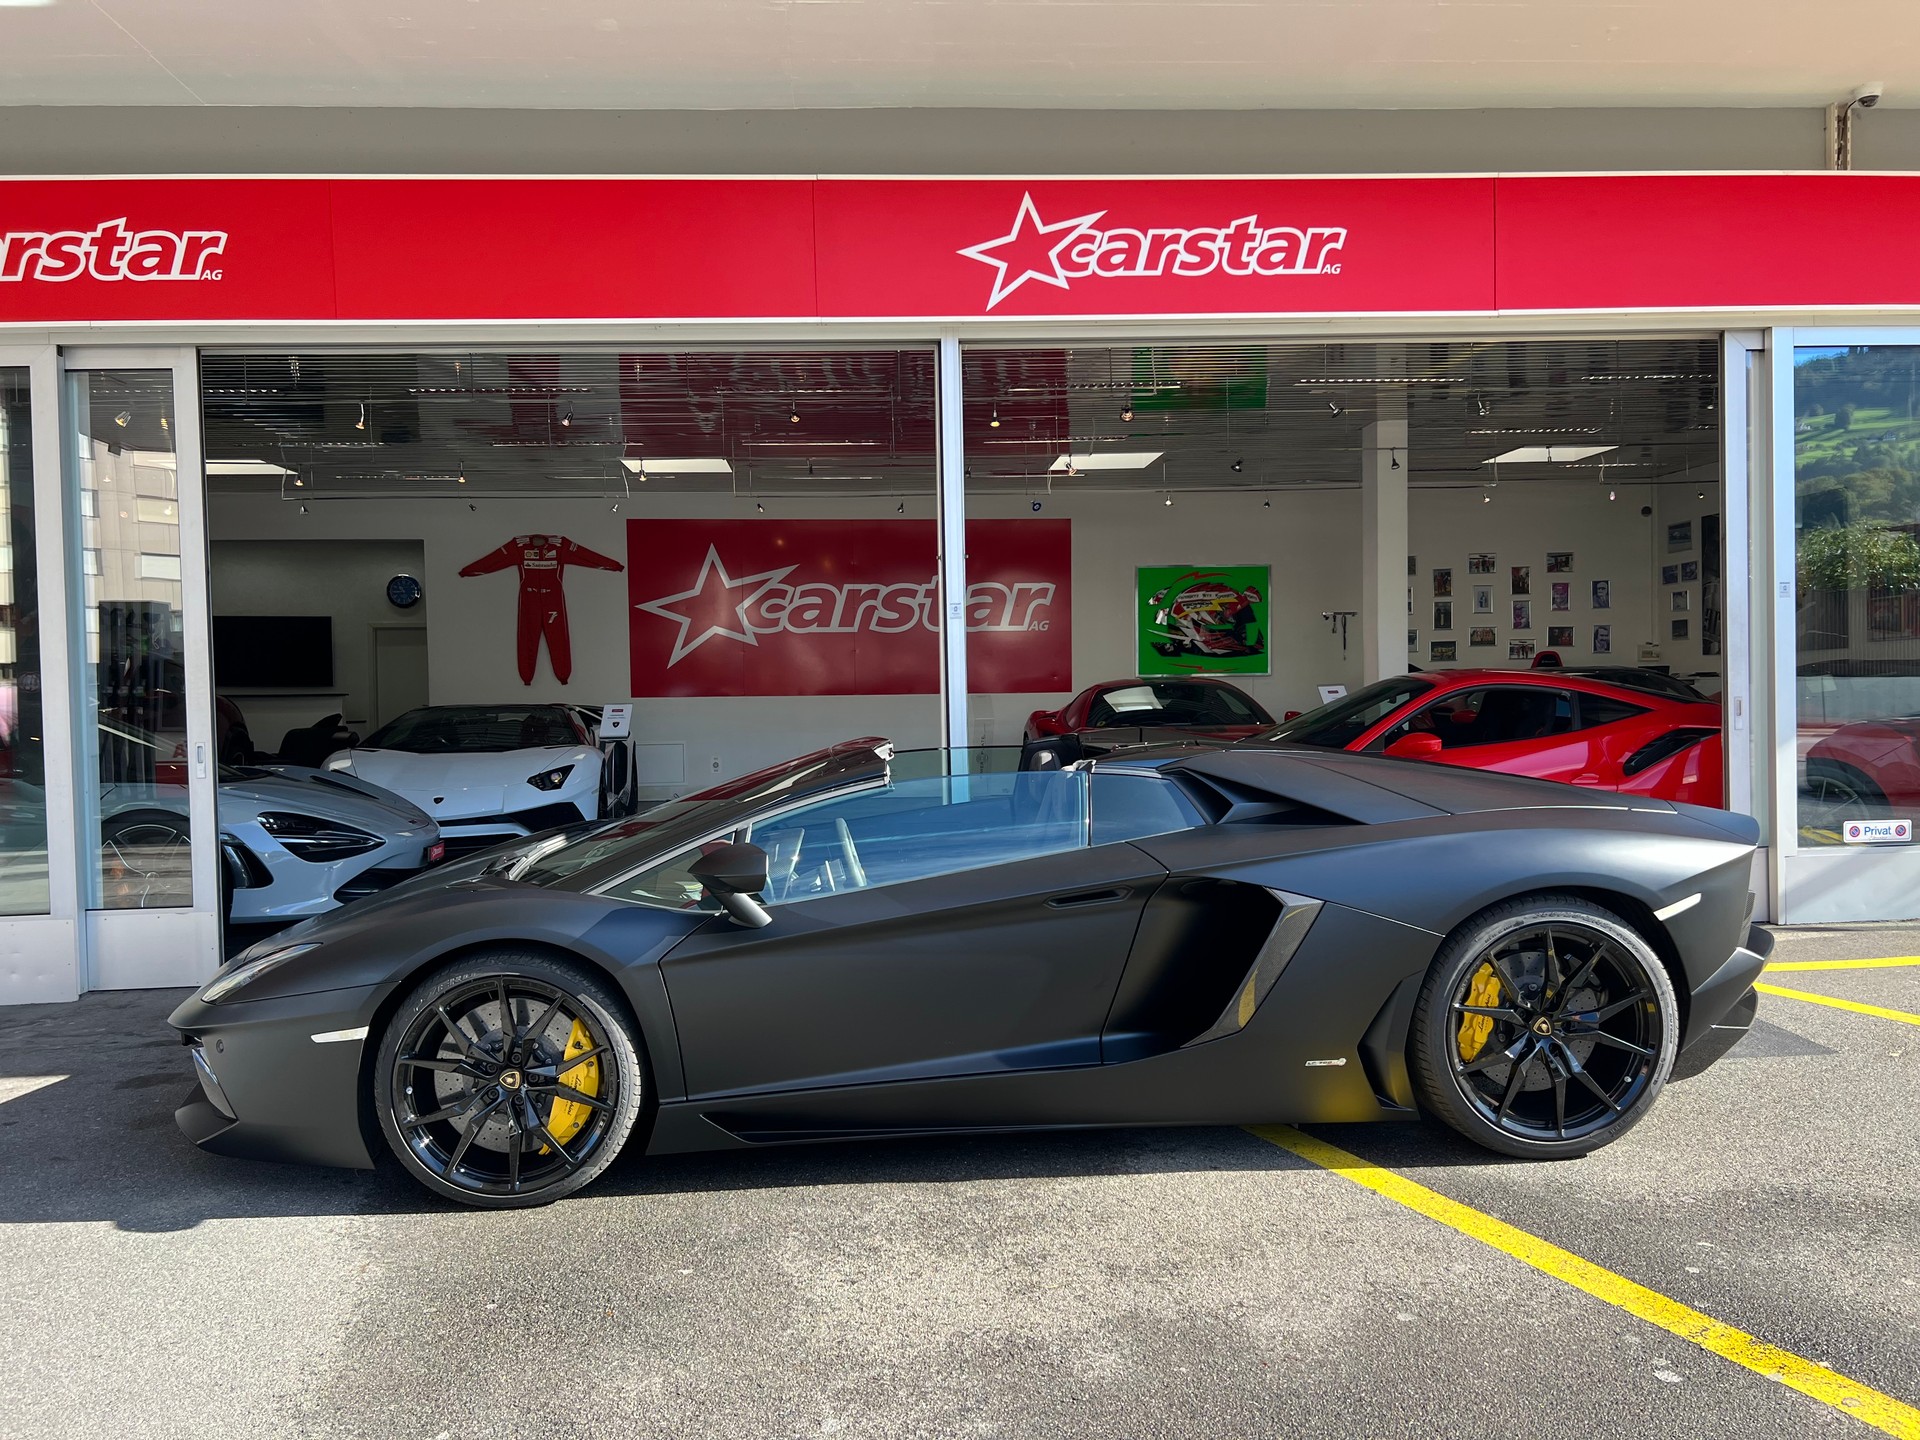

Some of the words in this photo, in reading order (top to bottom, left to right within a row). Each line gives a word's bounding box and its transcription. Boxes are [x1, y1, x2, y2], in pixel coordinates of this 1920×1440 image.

[0, 217, 228, 282] rstar
[201, 269, 223, 281] AG
[1055, 214, 1347, 277] carstar
[1321, 263, 1341, 275] AG
[548, 611, 558, 624] 7
[1028, 620, 1049, 631] AG
[1864, 826, 1892, 836] Privat
